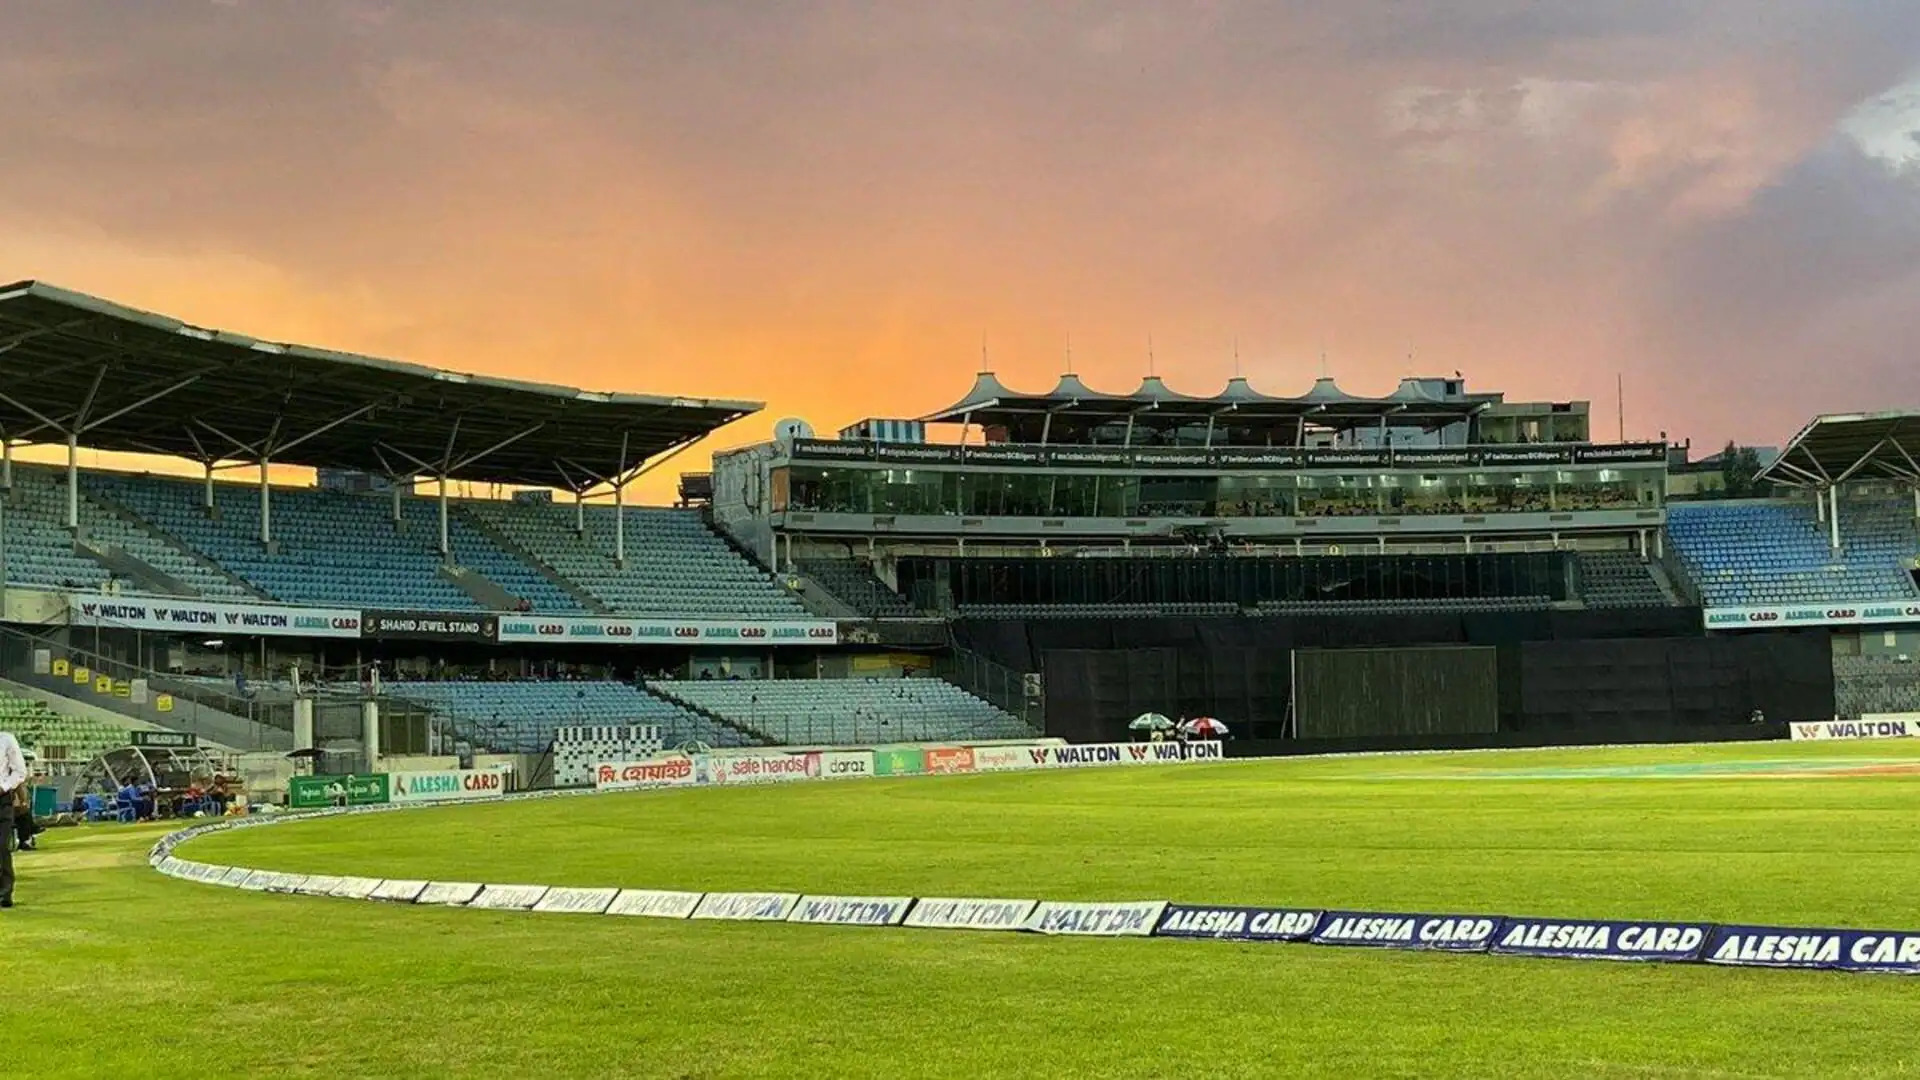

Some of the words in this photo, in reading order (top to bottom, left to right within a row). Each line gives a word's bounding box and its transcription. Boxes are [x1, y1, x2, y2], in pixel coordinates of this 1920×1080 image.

[100, 604, 146, 619] WALTON
[170, 609, 217, 624] WALTON
[1749, 612, 1778, 622] CARD
[1827, 609, 1856, 619] CARD
[241, 612, 287, 627] WALTON
[331, 616, 359, 630] CARD
[380, 619, 416, 631] SHAHID
[416, 620, 448, 632] JEWEL
[448, 621, 480, 633] STAND
[538, 624, 564, 635] CARD
[606, 625, 633, 636] CARD
[674, 626, 699, 637] CARD
[740, 627, 766, 638] CARD
[808, 627, 834, 638] CARD
[1826, 721, 1906, 737] WALTON
[1054, 746, 1121, 763] WALTON
[732, 757, 761, 775] safe
[761, 756, 804, 774] hands
[830, 758, 865, 773] daraz
[409, 775, 460, 793] ALESHA
[463, 773, 500, 791] CARD
[803, 900, 899, 923] WALTON
[1040, 907, 1153, 932] WALTON
[1162, 909, 1246, 934] ALESHA
[1249, 912, 1315, 935] CARD
[1320, 918, 1413, 941] ALESHA
[1418, 918, 1494, 942] CARD
[1500, 924, 1611, 950] ALESHA
[1617, 926, 1702, 952] CARD
[1713, 935, 1841, 962] ALESHA
